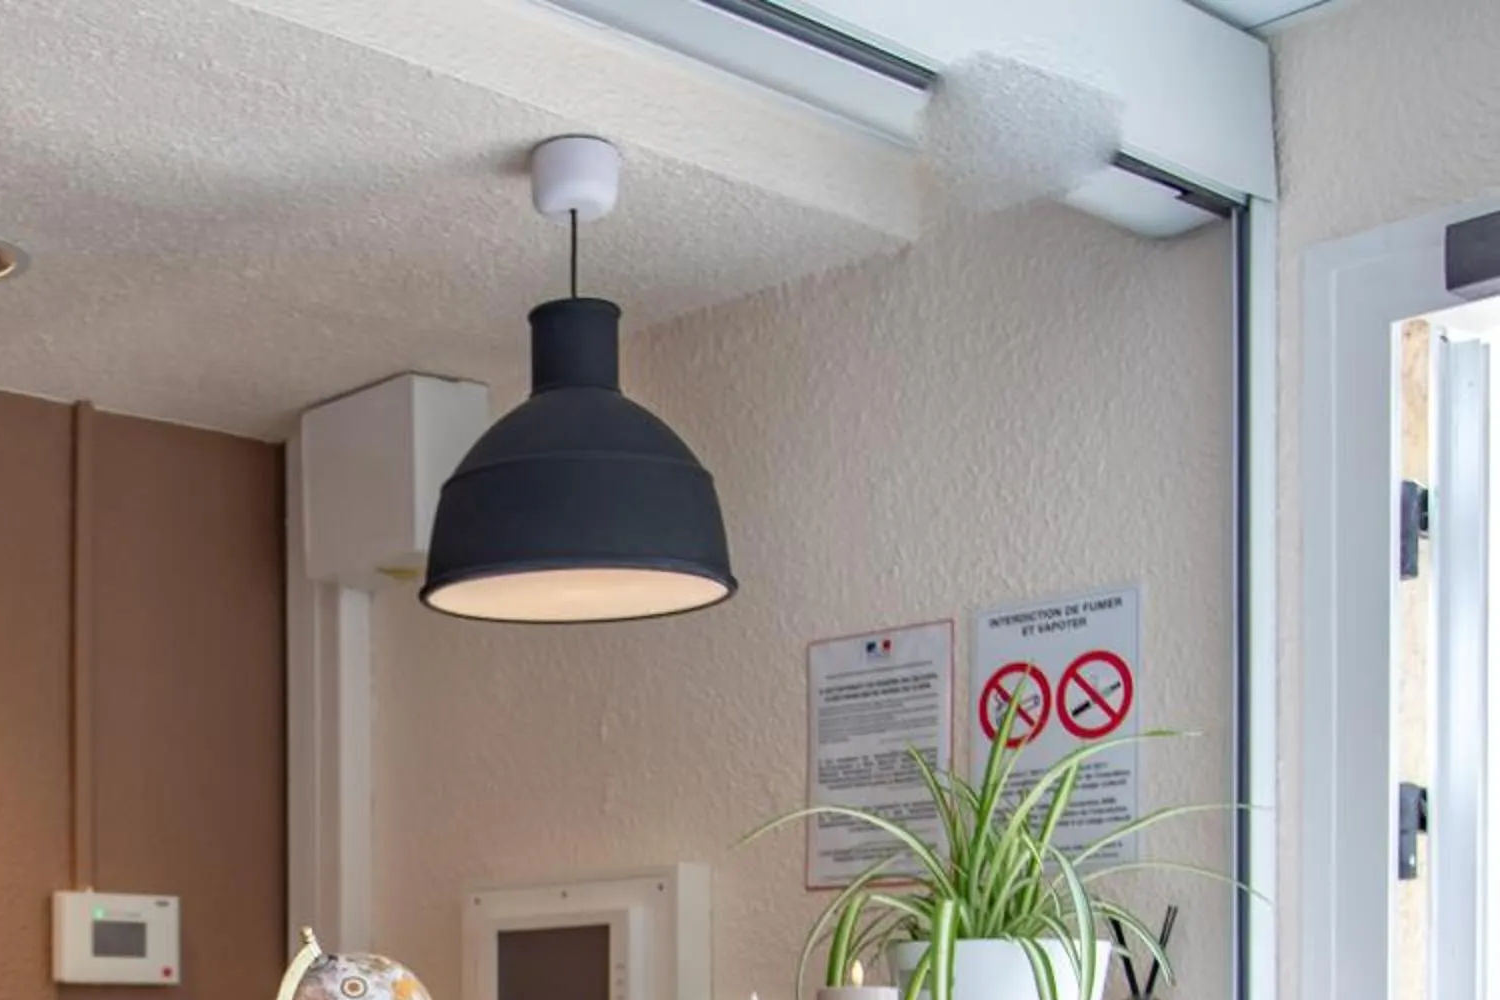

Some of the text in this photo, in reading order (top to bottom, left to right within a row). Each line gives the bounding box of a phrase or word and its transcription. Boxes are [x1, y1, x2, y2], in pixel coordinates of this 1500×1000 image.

[989, 596, 1122, 628] INTERDICTION DE FUMER
[1021, 617, 1087, 637] ET VAPOTER
